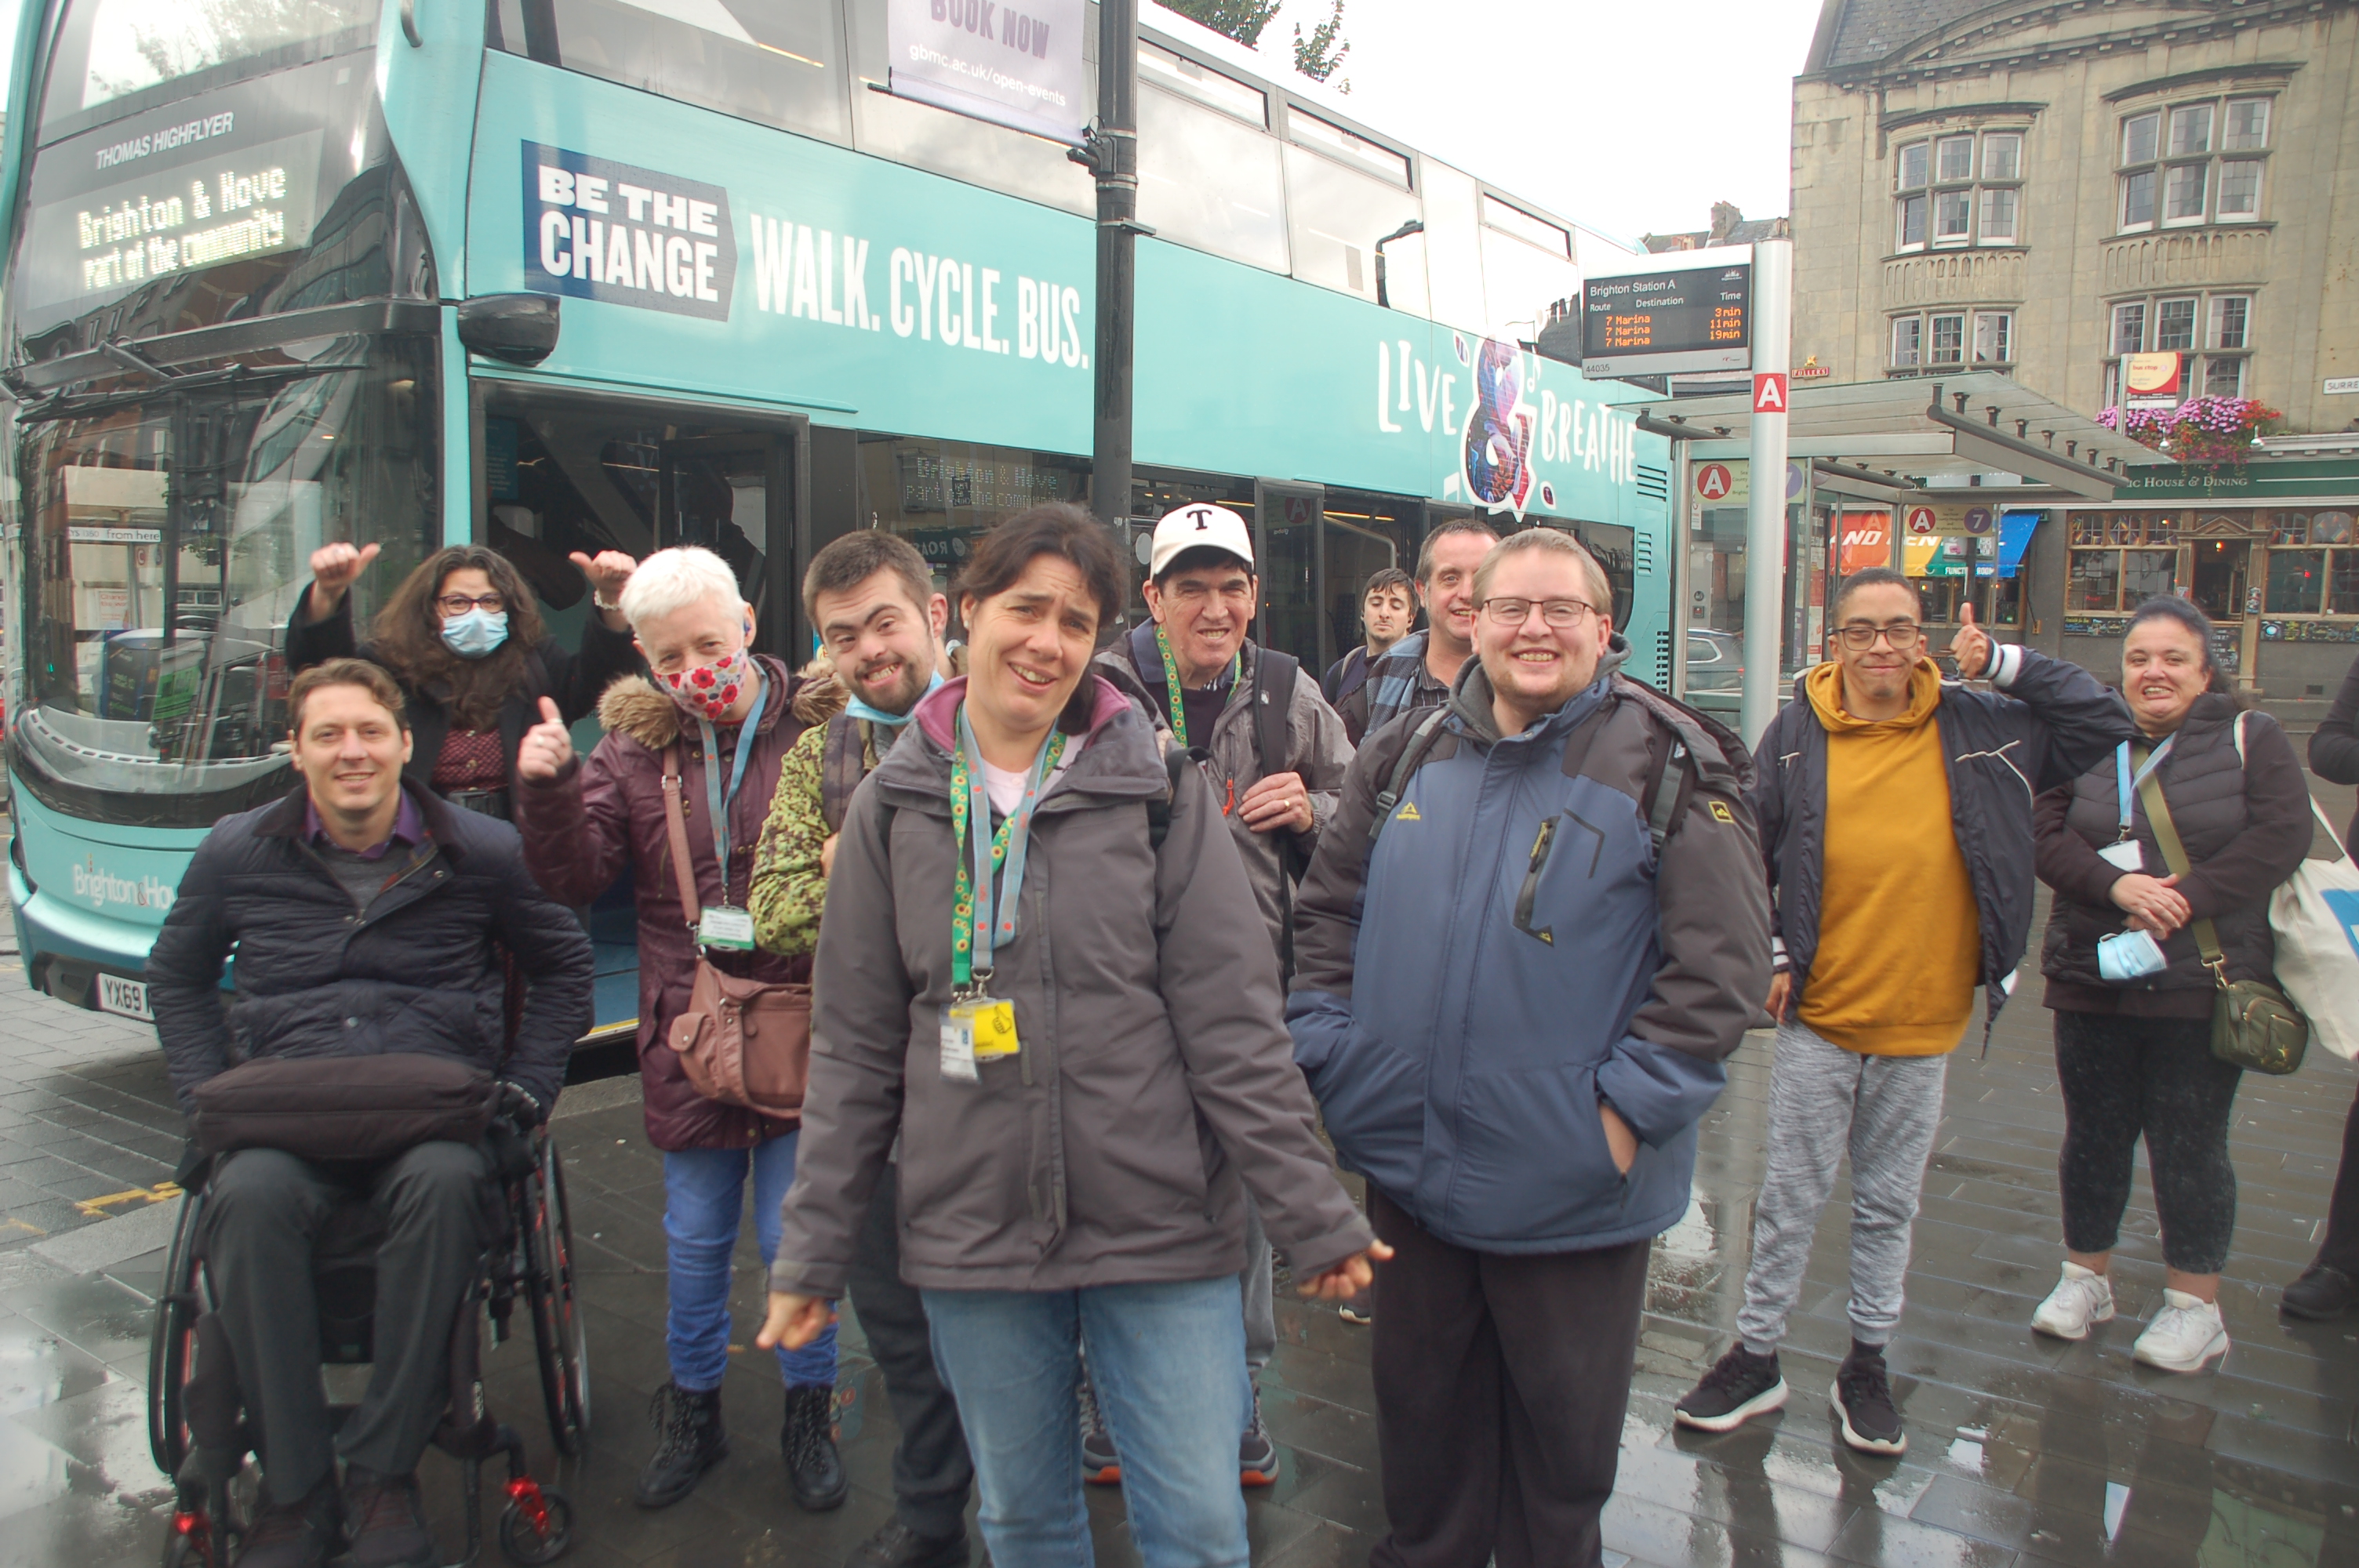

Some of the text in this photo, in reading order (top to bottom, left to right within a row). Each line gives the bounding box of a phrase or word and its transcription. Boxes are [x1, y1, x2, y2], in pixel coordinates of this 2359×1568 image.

[930, 0, 1050, 60] BOOK NOW
[909, 44, 1066, 106] gbmc.ac.uk/open-events
[96, 111, 234, 169] THOMAS HIGHFLYER
[78, 168, 286, 249] Brighton & Hove
[539, 165, 718, 238] BE THE
[148, 236, 179, 275] the
[540, 211, 718, 303] CHANGE
[751, 213, 1089, 369] WALK. CYCLE. BUS.
[1590, 280, 1676, 297] Brighton Station A
[1590, 292, 1742, 312] Route Destination Time
[1605, 327, 1612, 336] 7
[1616, 325, 1651, 336] Marina
[1606, 316, 1613, 326] 7
[1616, 314, 1651, 325] Marina
[1605, 338, 1612, 347] 7
[1615, 336, 1651, 347] Marina
[1585, 364, 1610, 373] 44035
[1757, 378, 1783, 408] A
[1378, 340, 1457, 435] LIVE
[1541, 390, 1637, 485] BREATHE
[917, 456, 1057, 490] Brighton & Hove
[1703, 469, 1725, 495] A
[107, 528, 133, 539] from
[136, 530, 160, 541] here
[1187, 510, 1212, 530] T
[1914, 511, 1931, 530] A
[1972, 514, 1984, 529] 7
[105, 978, 142, 1012] YX69
